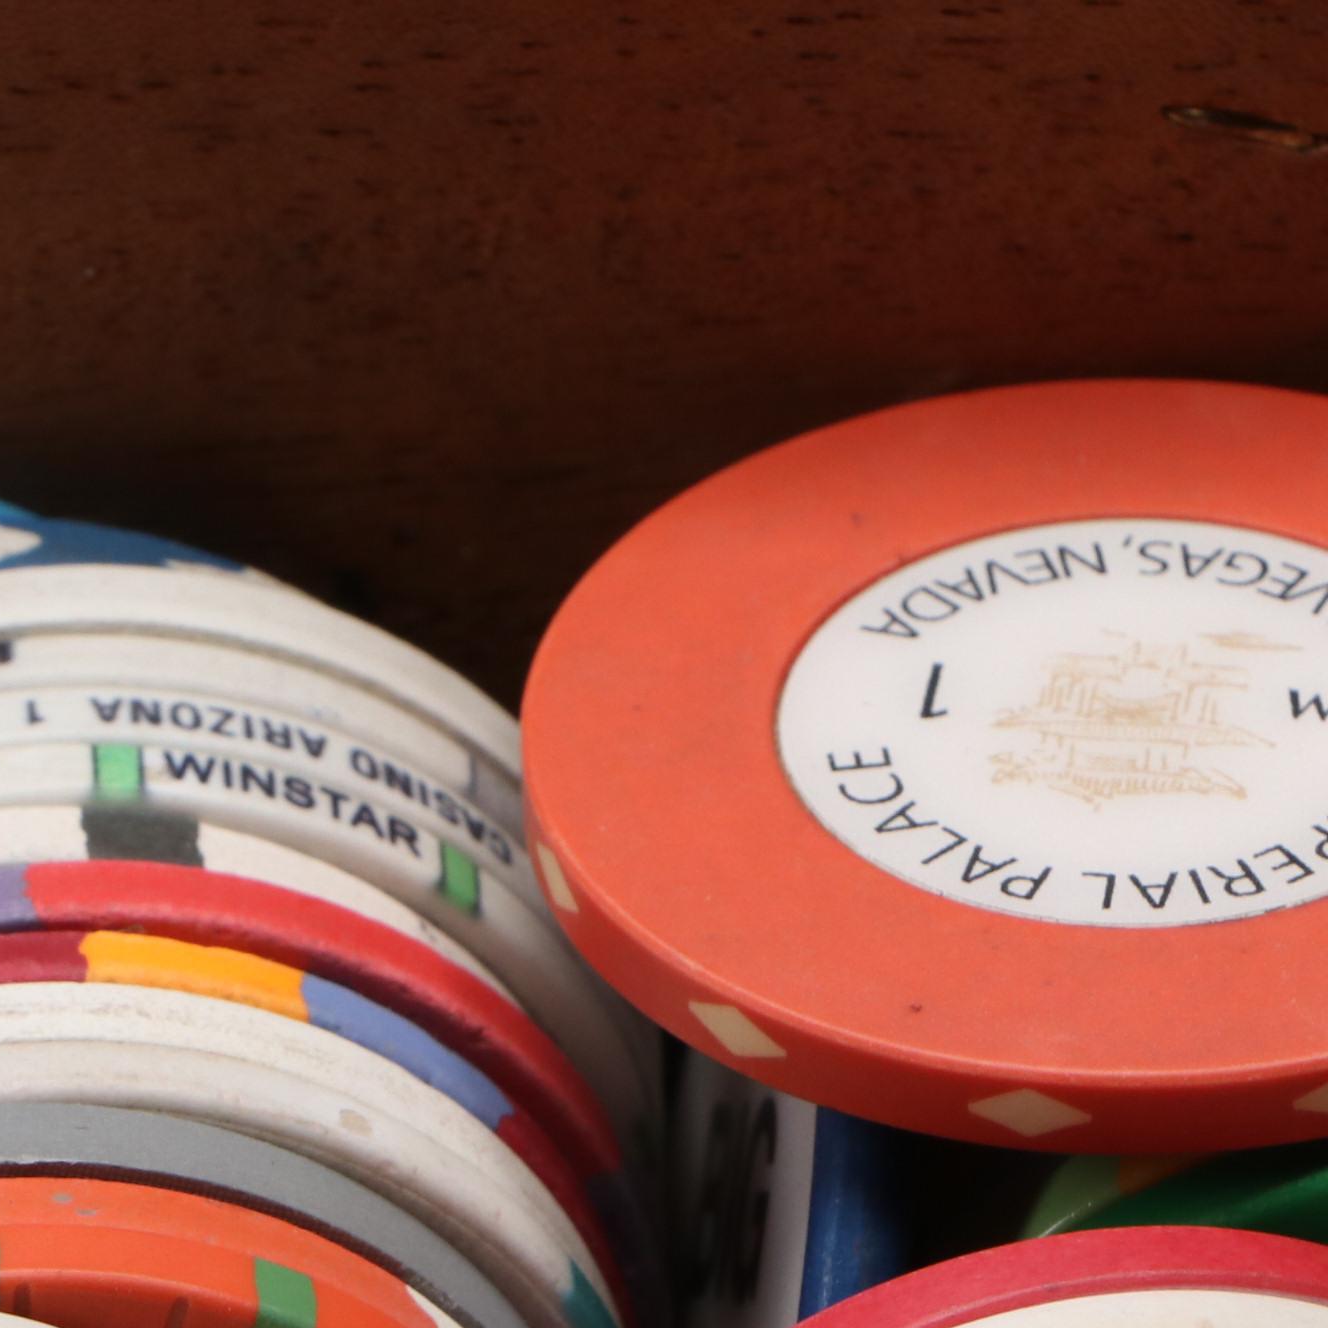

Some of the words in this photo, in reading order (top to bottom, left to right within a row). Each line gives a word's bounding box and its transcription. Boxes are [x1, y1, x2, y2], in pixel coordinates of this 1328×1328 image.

[862, 541, 1107, 641] NEVADA
[90, 696, 327, 758] ARIZONA
[919, 662, 949, 720] 1
[163, 750, 422, 857] WINSTAR
[350, 748, 514, 867] CASINO
[827, 746, 1052, 901] PALACE
